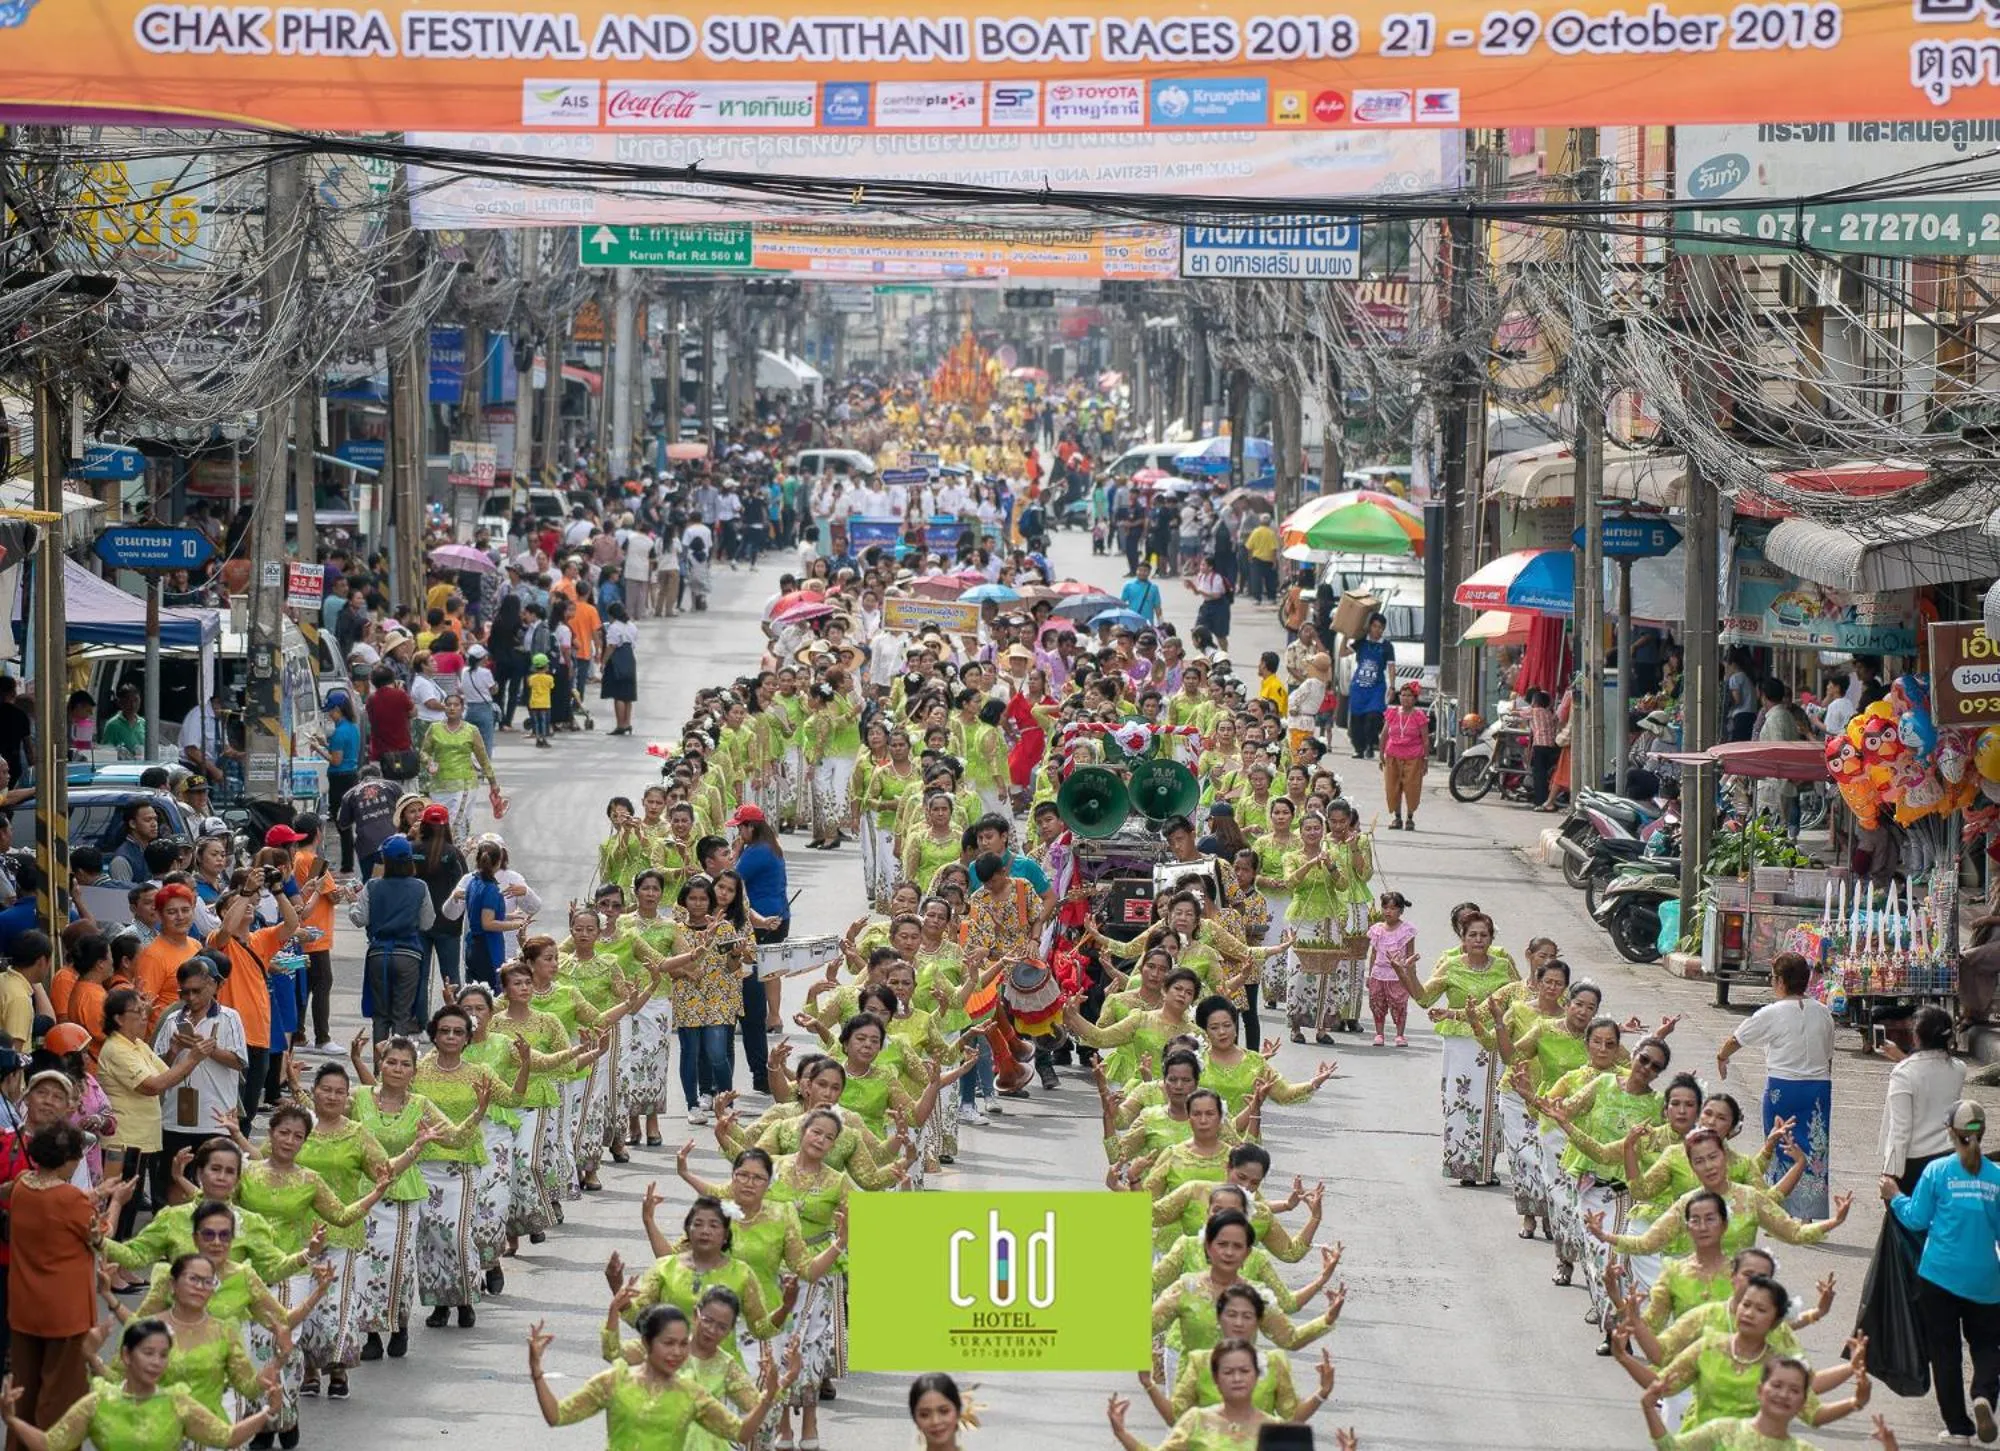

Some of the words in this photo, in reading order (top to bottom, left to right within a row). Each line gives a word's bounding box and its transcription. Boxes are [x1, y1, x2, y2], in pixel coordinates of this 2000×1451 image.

[142, 11, 264, 48] CHAK
[283, 14, 390, 51] PHRA
[409, 17, 579, 53] FESTIVAL
[597, 20, 690, 54] AND
[708, 21, 963, 55] SURATTHANI
[981, 23, 1089, 55] BOAT
[1107, 22, 1235, 55] RACES
[1251, 21, 1353, 55] 2018
[1386, 19, 1430, 51] 21
[1485, 17, 1535, 49] 29
[1552, 9, 1718, 47] October
[1736, 9, 1836, 44] 2018
[1076, 86, 1138, 99] TOYOTA
[1192, 88, 1262, 105] Krungthai
[561, 96, 589, 108] AIS
[1697, 158, 1742, 190] รับทำ
[629, 250, 664, 261] Karun
[667, 250, 687, 261] Rat
[1191, 254, 1209, 273] ยา
[1215, 252, 1300, 275] อาหารเสริม
[1306, 256, 1352, 275] นมผง
[122, 455, 134, 472] 12
[1652, 529, 1665, 546] 5
[118, 551, 139, 559] CHON
[181, 539, 197, 559] 10
[1844, 632, 1914, 651] KUMON
